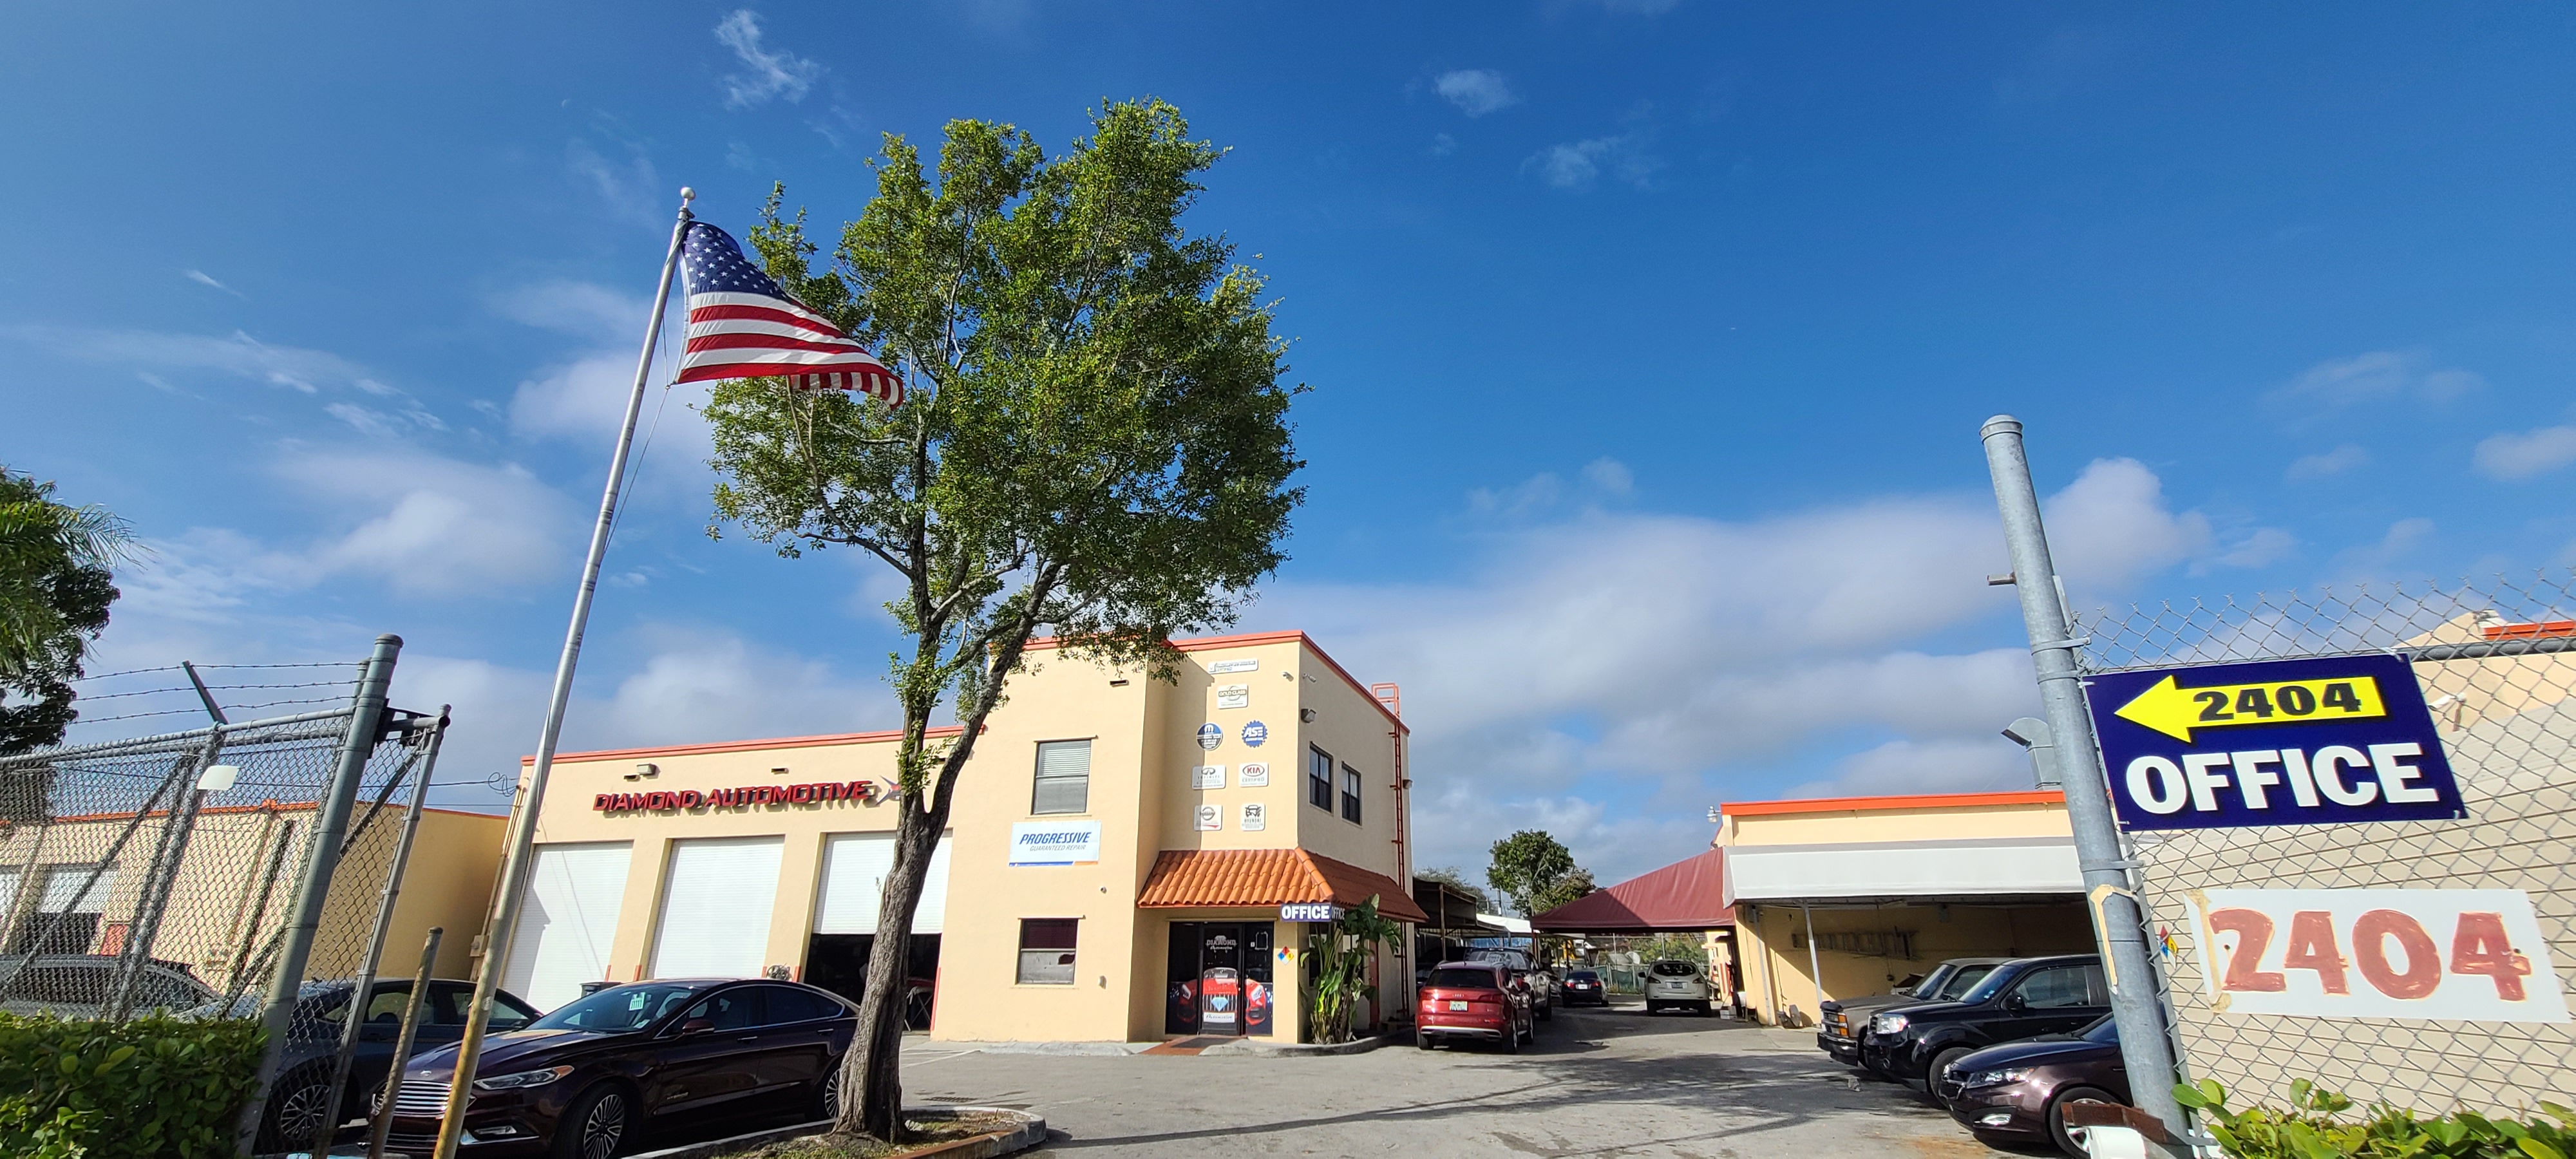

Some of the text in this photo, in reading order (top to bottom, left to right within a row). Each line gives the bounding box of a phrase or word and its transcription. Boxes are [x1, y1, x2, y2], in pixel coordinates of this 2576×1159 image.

[2193, 683, 2362, 721] 2404
[1244, 726, 1264, 737] ASE
[2126, 742, 2439, 814] OFFICE
[592, 780, 872, 811] DIAMOND AUTOMOTIVE
[1019, 832, 1092, 845] PROGRESSIVE
[1282, 905, 1330, 919] OFFICE
[1331, 907, 1345, 919] OFFICE
[2208, 907, 2532, 1002] 2404
